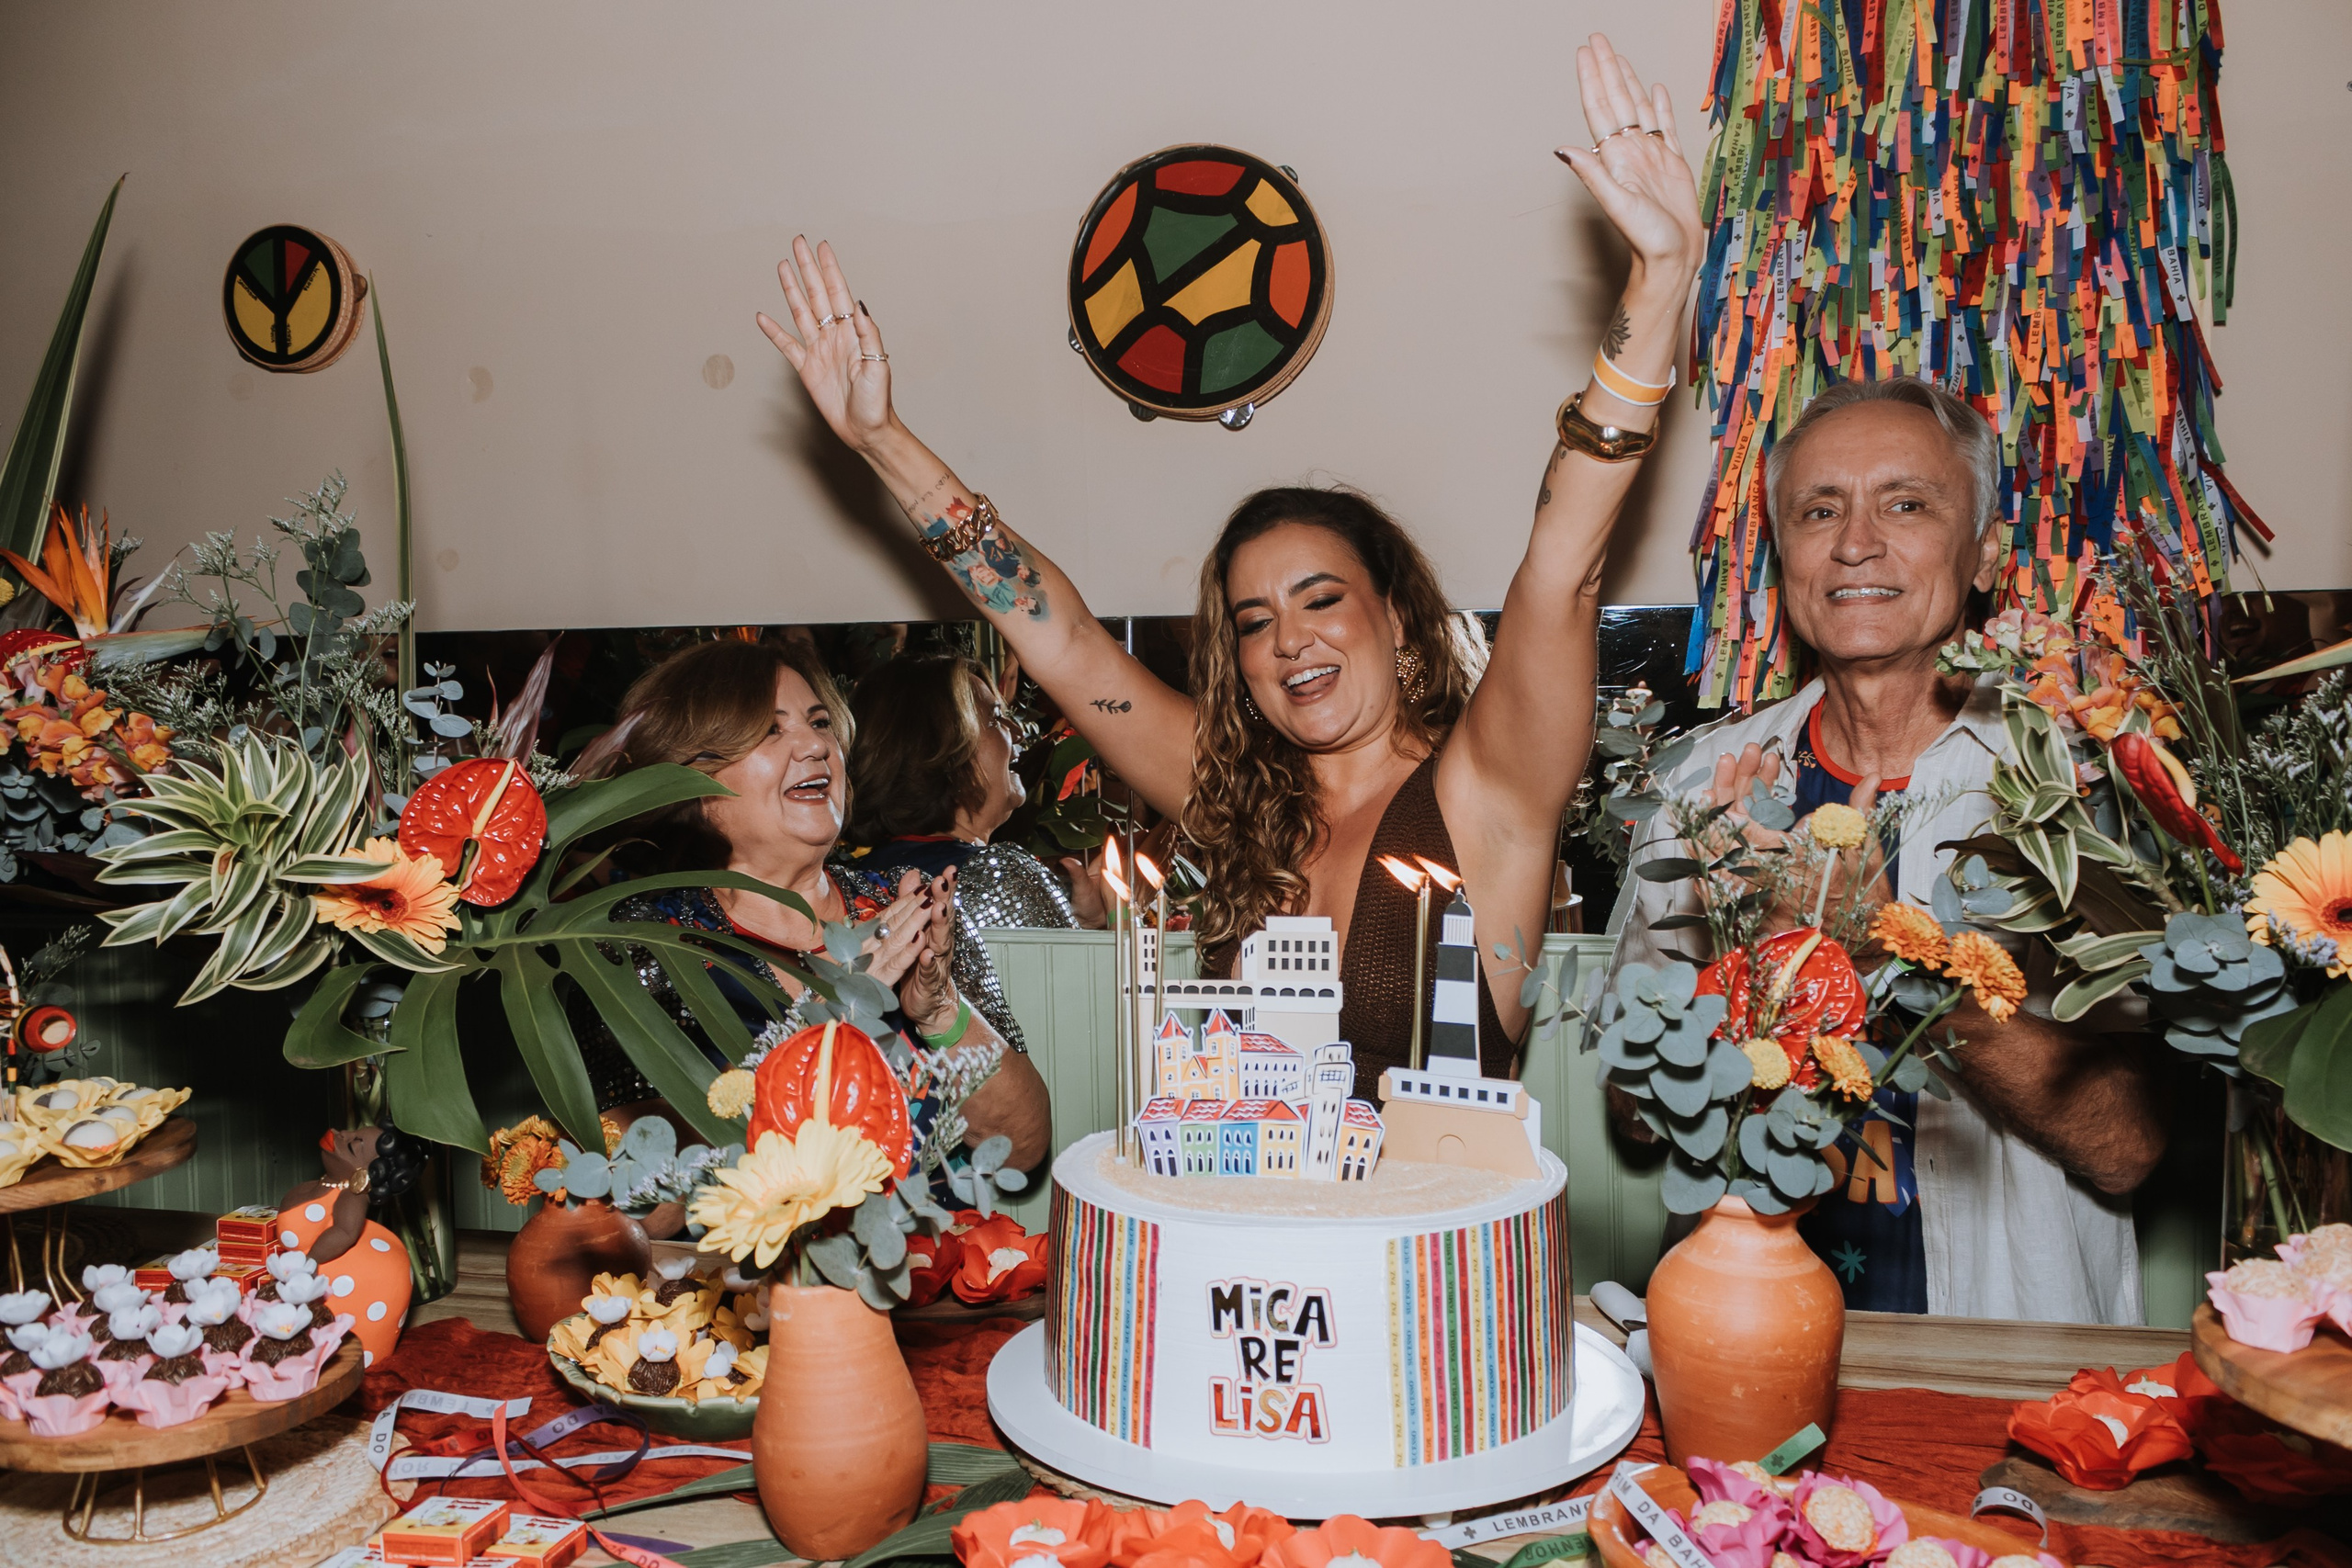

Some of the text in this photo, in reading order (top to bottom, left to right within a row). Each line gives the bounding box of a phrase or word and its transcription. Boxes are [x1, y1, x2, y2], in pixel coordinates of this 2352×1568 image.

[1999, 0, 2007, 39] LEMBR
[2055, 0, 2064, 53] LEMBRA
[2129, 0, 2138, 56] LEMBRAN
[1840, 50, 1854, 85] BAHIA
[1731, 122, 1742, 158] BAHIA
[1757, 241, 1774, 283] LEMBR
[1777, 243, 1786, 301] LEMBRAN
[2167, 249, 2182, 286] BAHIA
[2214, 239, 2222, 279] BAHIA
[2030, 291, 2044, 344] LEMBRA
[1949, 362, 1962, 396] BAHIA
[2176, 409, 2191, 446] BAHIA
[1731, 436, 1749, 471] BAHIA
[2198, 487, 2217, 553] LEMBRAN
[1720, 559, 1729, 594] BAHIA
[1239, 1337, 1300, 1383] RE
[373, 1433, 387, 1454] DO
[551, 1415, 579, 1434] DO
[2003, 1493, 2034, 1513] DO
[1636, 1501, 1661, 1526] DA
[1668, 1533, 1706, 1568] BAH
